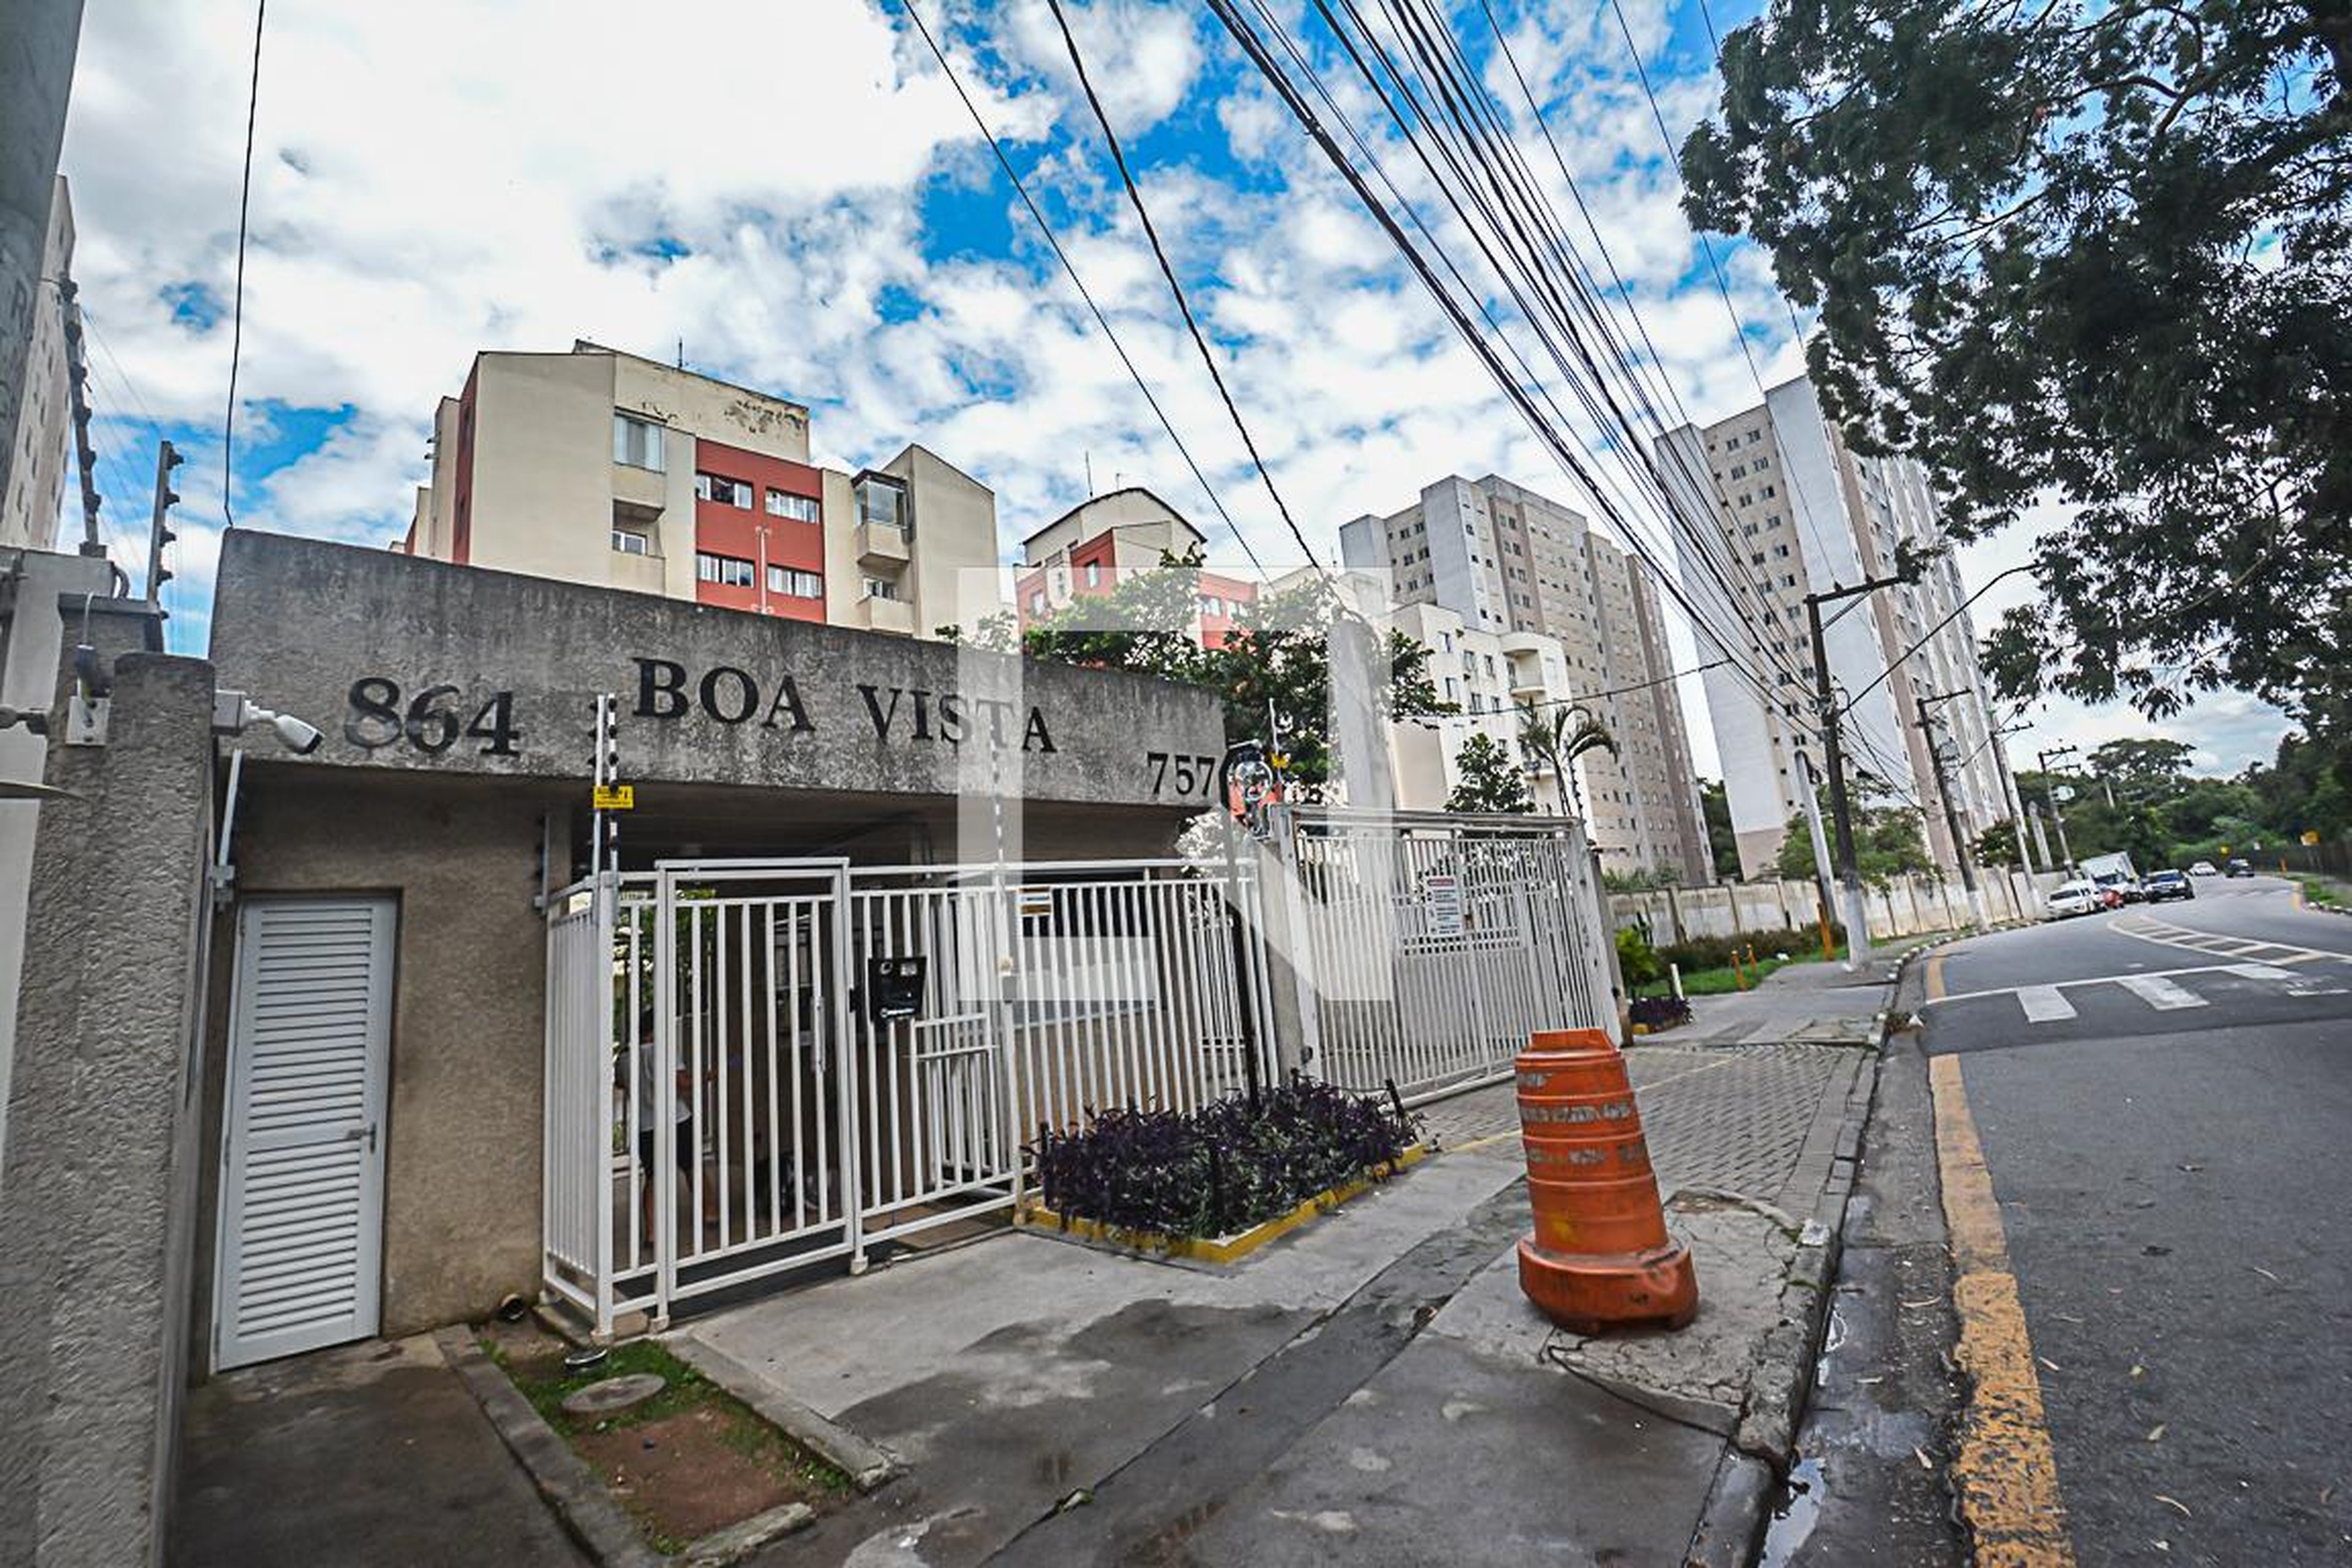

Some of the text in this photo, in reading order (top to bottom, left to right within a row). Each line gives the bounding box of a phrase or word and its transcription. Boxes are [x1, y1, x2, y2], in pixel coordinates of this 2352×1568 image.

[344, 677, 521, 756] 864
[631, 657, 1057, 753] BOA VISTA
[1147, 751, 1215, 796] 757
